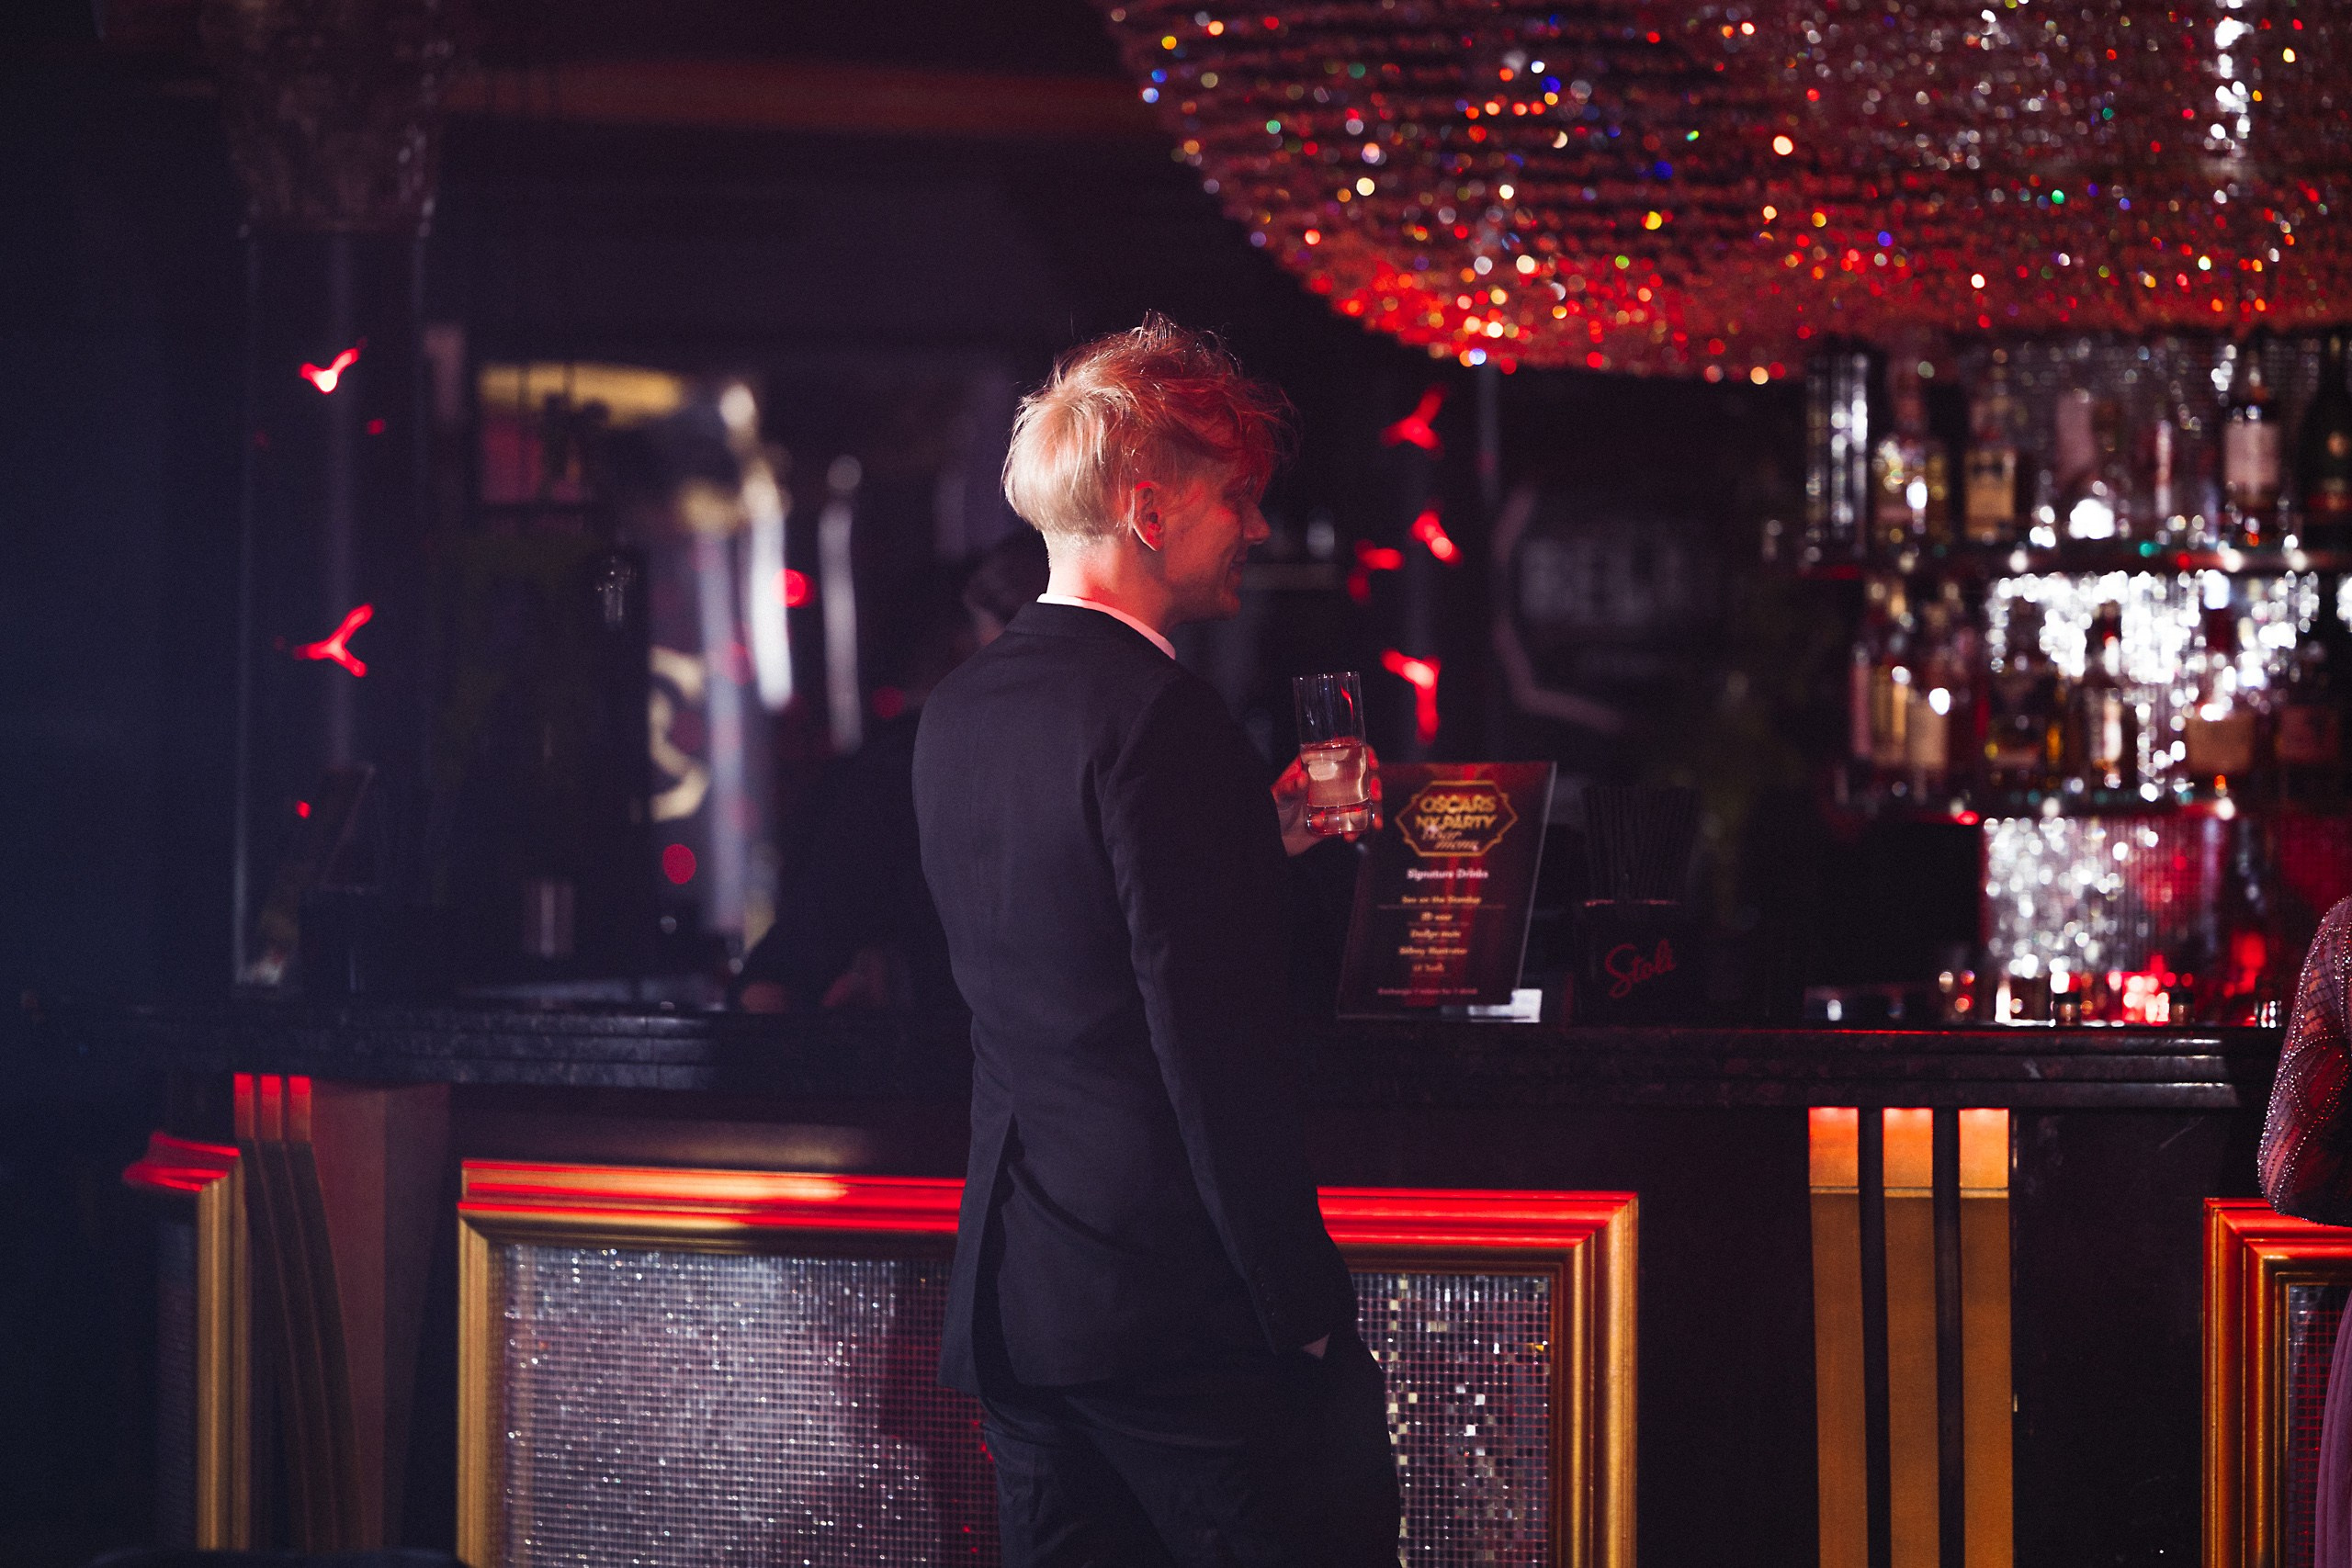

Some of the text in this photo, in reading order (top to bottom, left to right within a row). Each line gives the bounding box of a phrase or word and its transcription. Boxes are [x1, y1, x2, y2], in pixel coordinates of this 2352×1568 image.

[1420, 795, 1496, 814] OSCARS
[1442, 814, 1498, 829] PARTY
[1407, 868, 1454, 881] Signature
